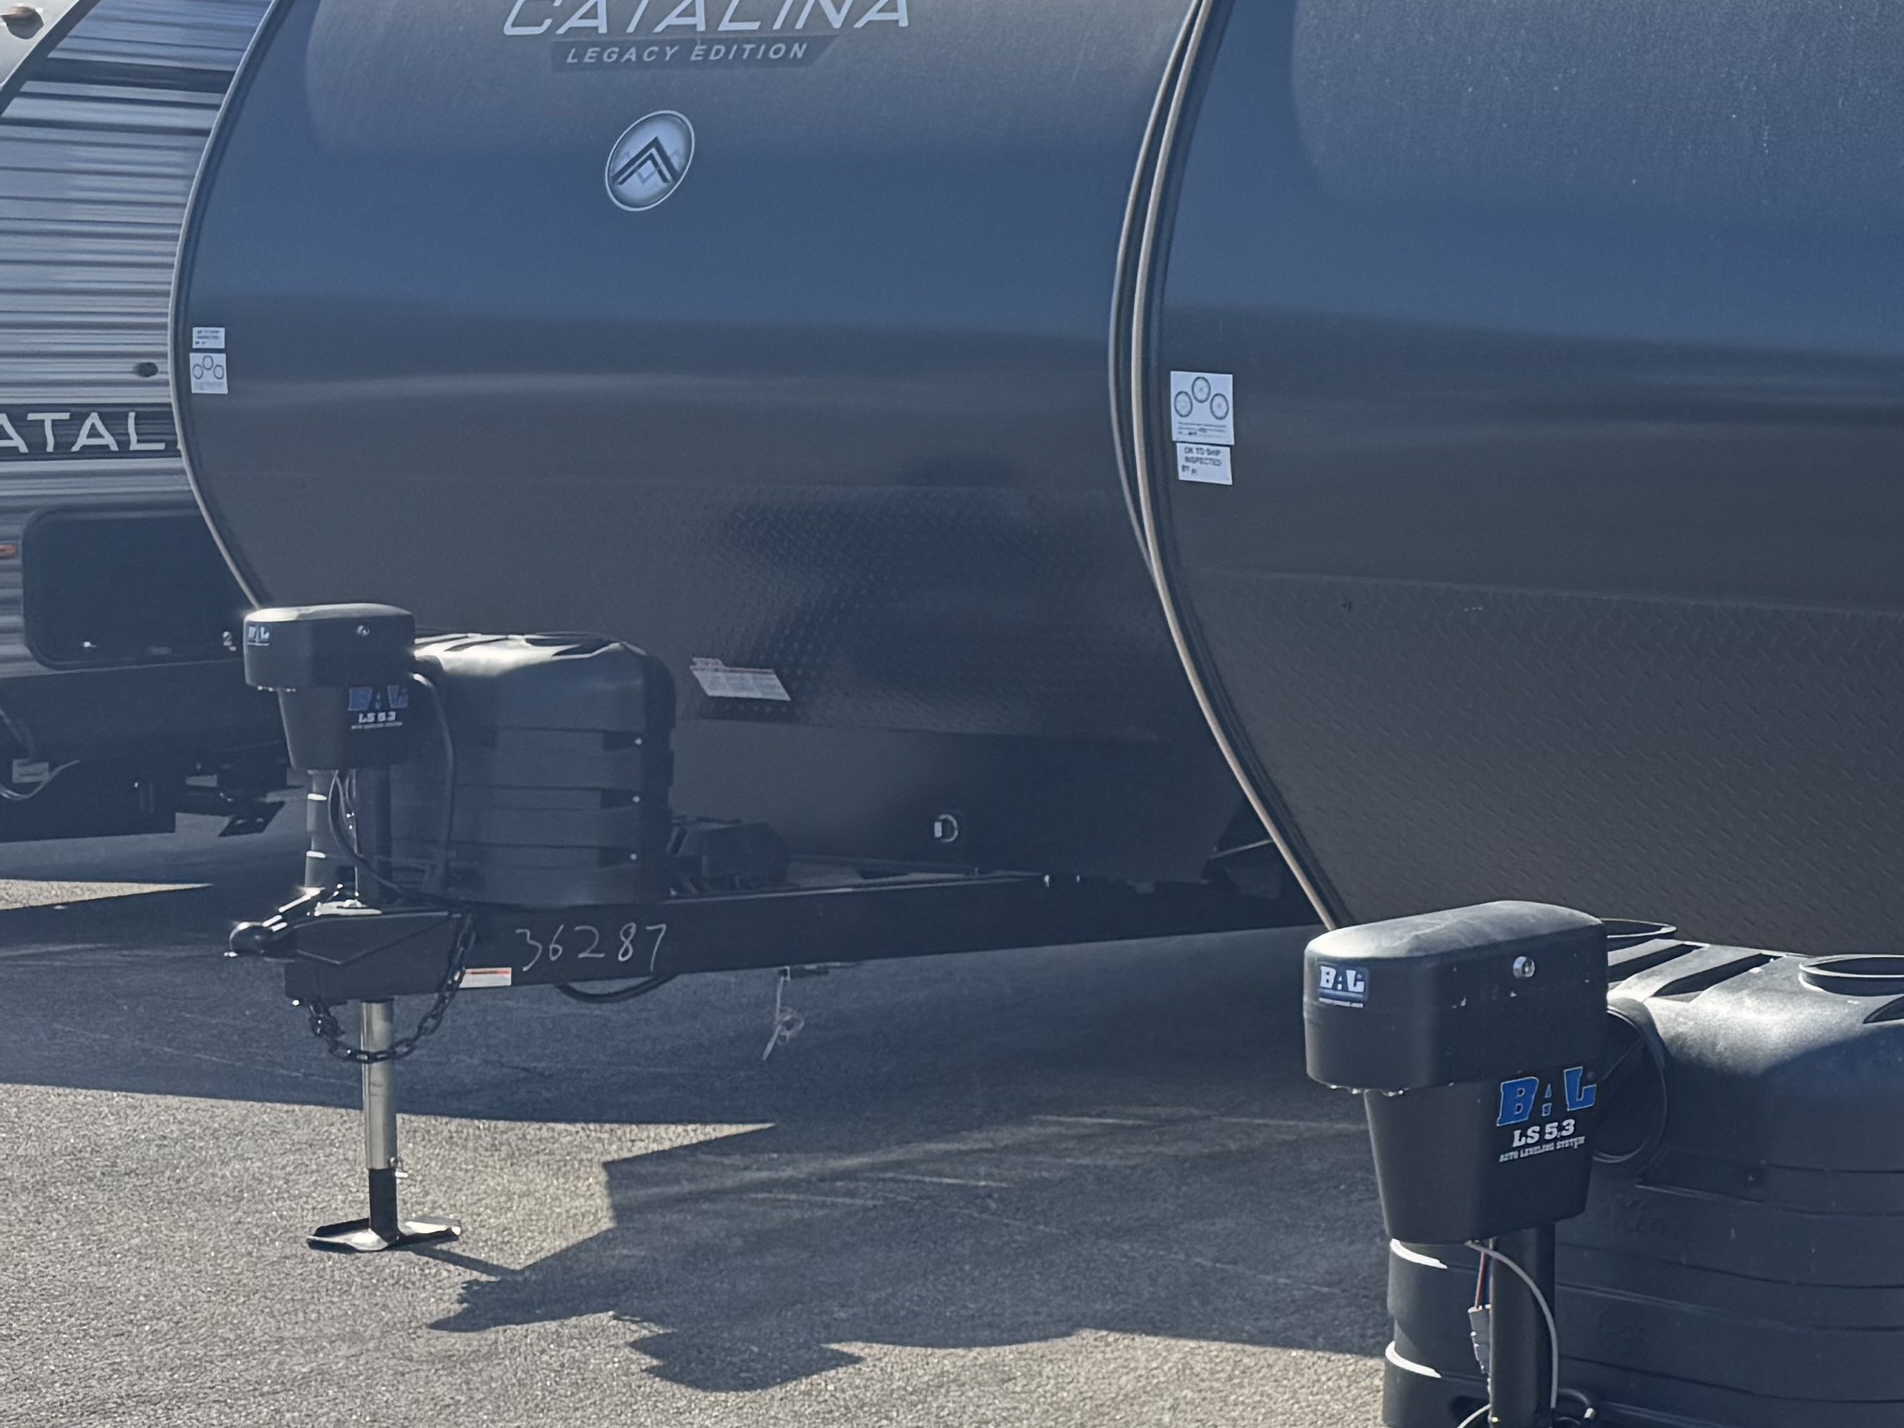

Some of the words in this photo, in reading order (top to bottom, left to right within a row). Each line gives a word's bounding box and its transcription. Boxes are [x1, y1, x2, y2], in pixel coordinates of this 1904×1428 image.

[565, 44, 681, 64] LEGACY
[690, 41, 808, 62] EDITION
[0, 411, 182, 454] ATAL
[515, 922, 667, 972] 36287
[1496, 1065, 1597, 1126] BAL
[1512, 1125, 1541, 1148] LS
